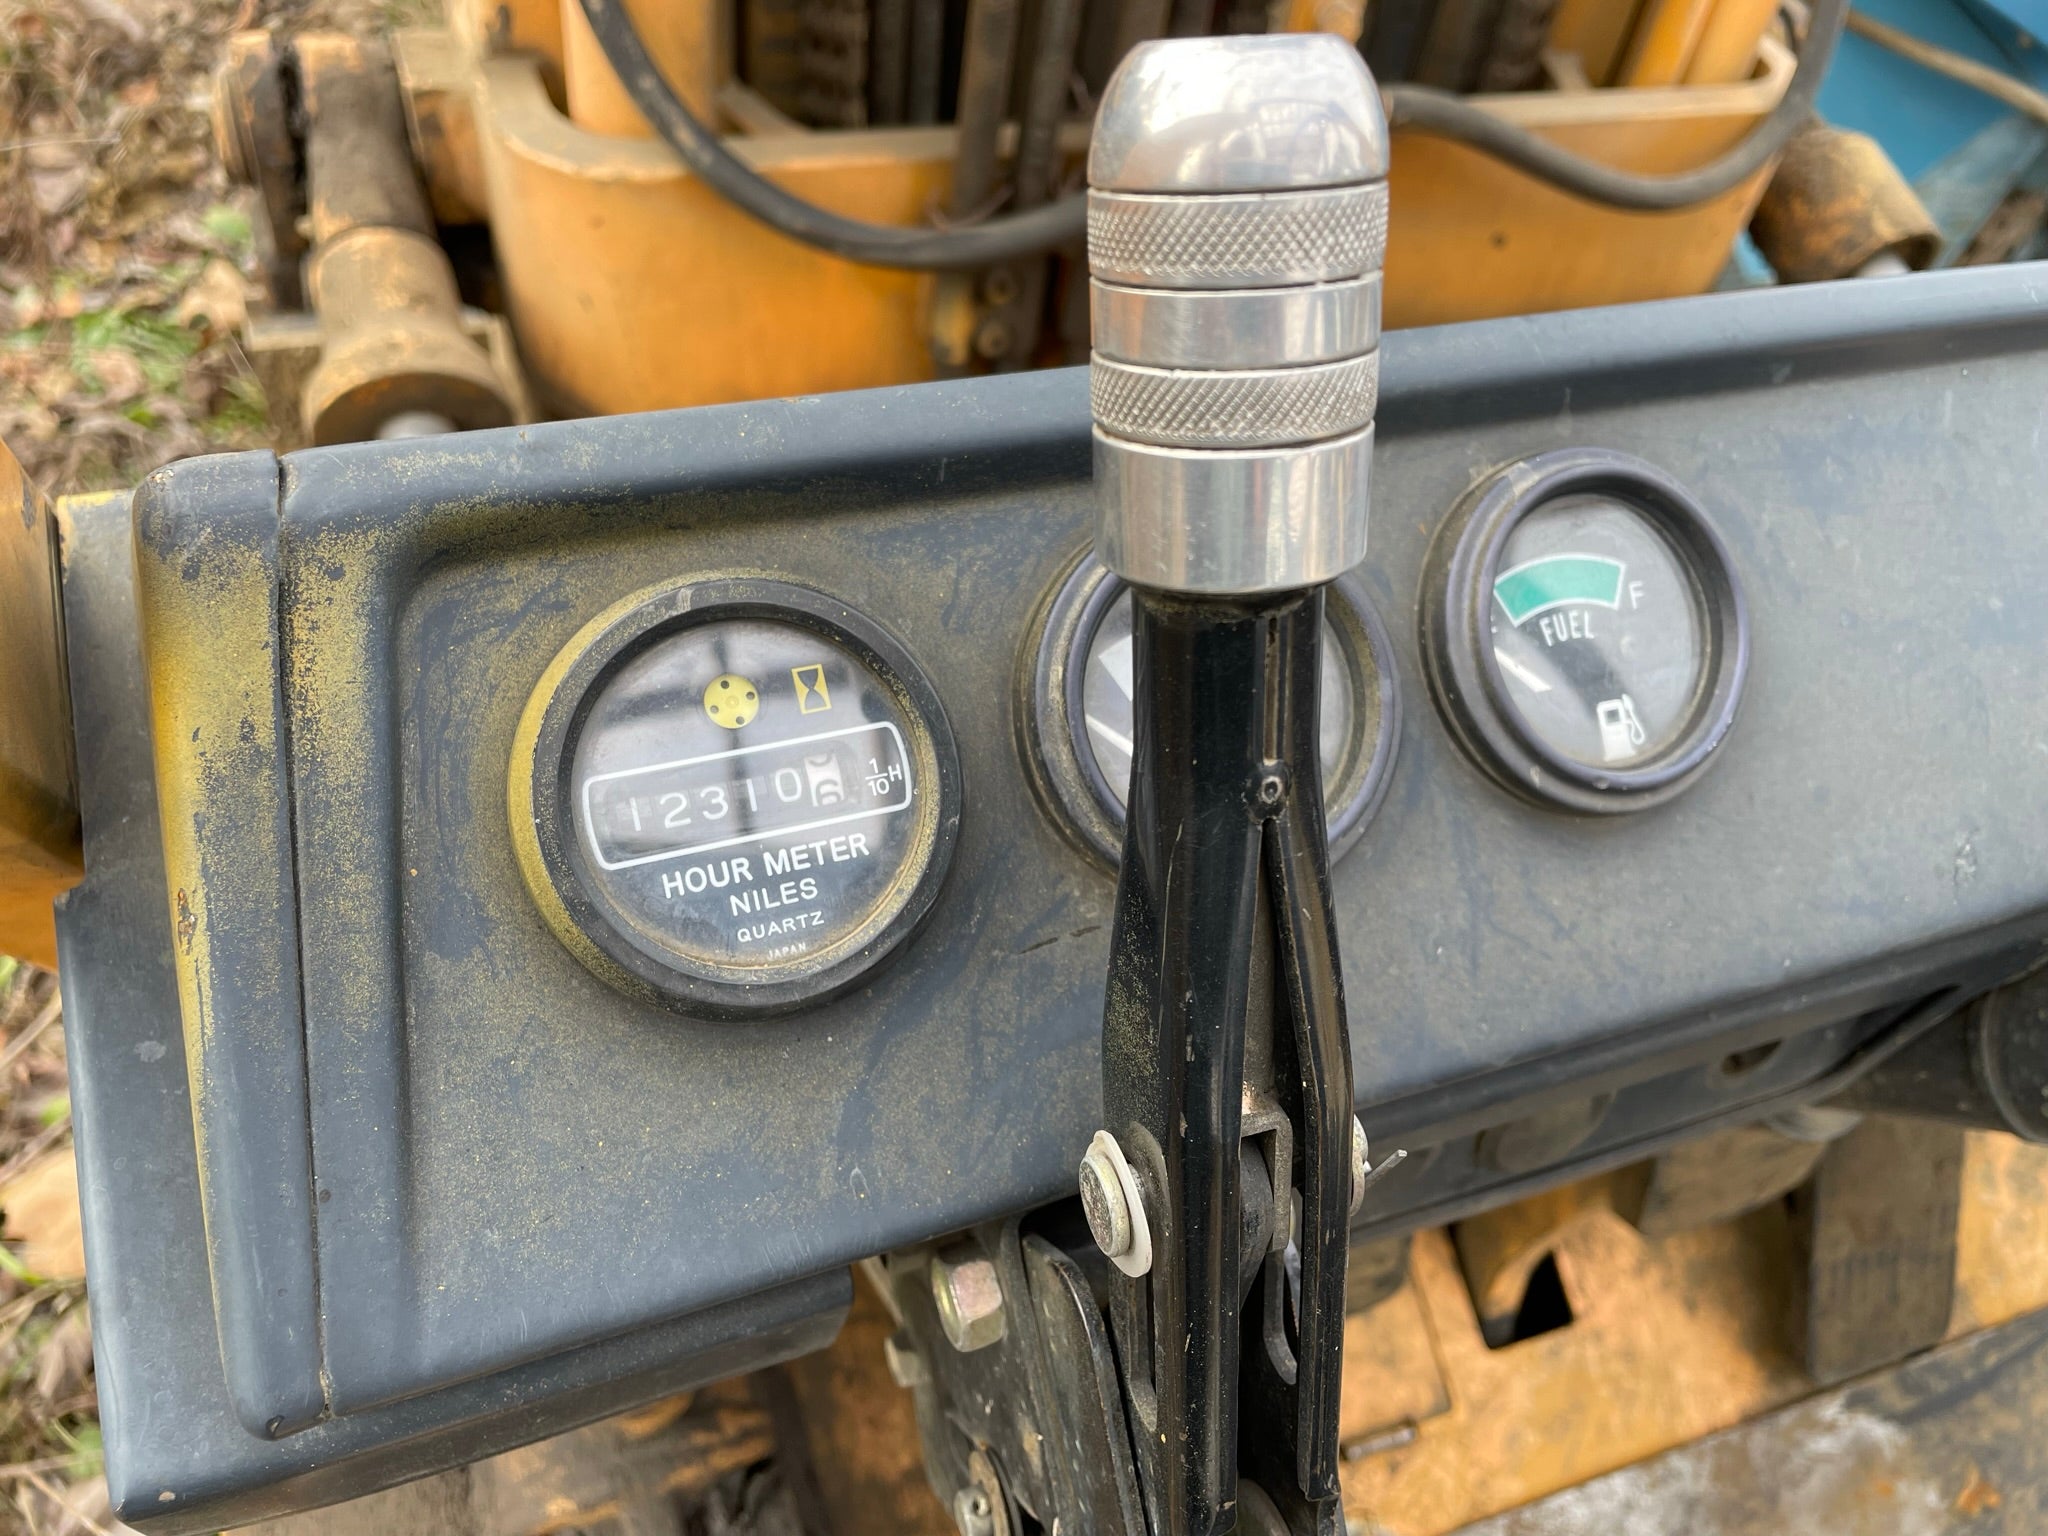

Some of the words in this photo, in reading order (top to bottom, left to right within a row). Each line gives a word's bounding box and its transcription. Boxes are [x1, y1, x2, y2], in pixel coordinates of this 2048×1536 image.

[1628, 580, 1645, 610] F
[1539, 610, 1595, 647] FUEL
[661, 856, 753, 899] HOUR
[764, 833, 871, 876] METER
[729, 878, 818, 917] NILES
[737, 910, 825, 943] QUARTZ
[766, 942, 807, 961] JAPAN
